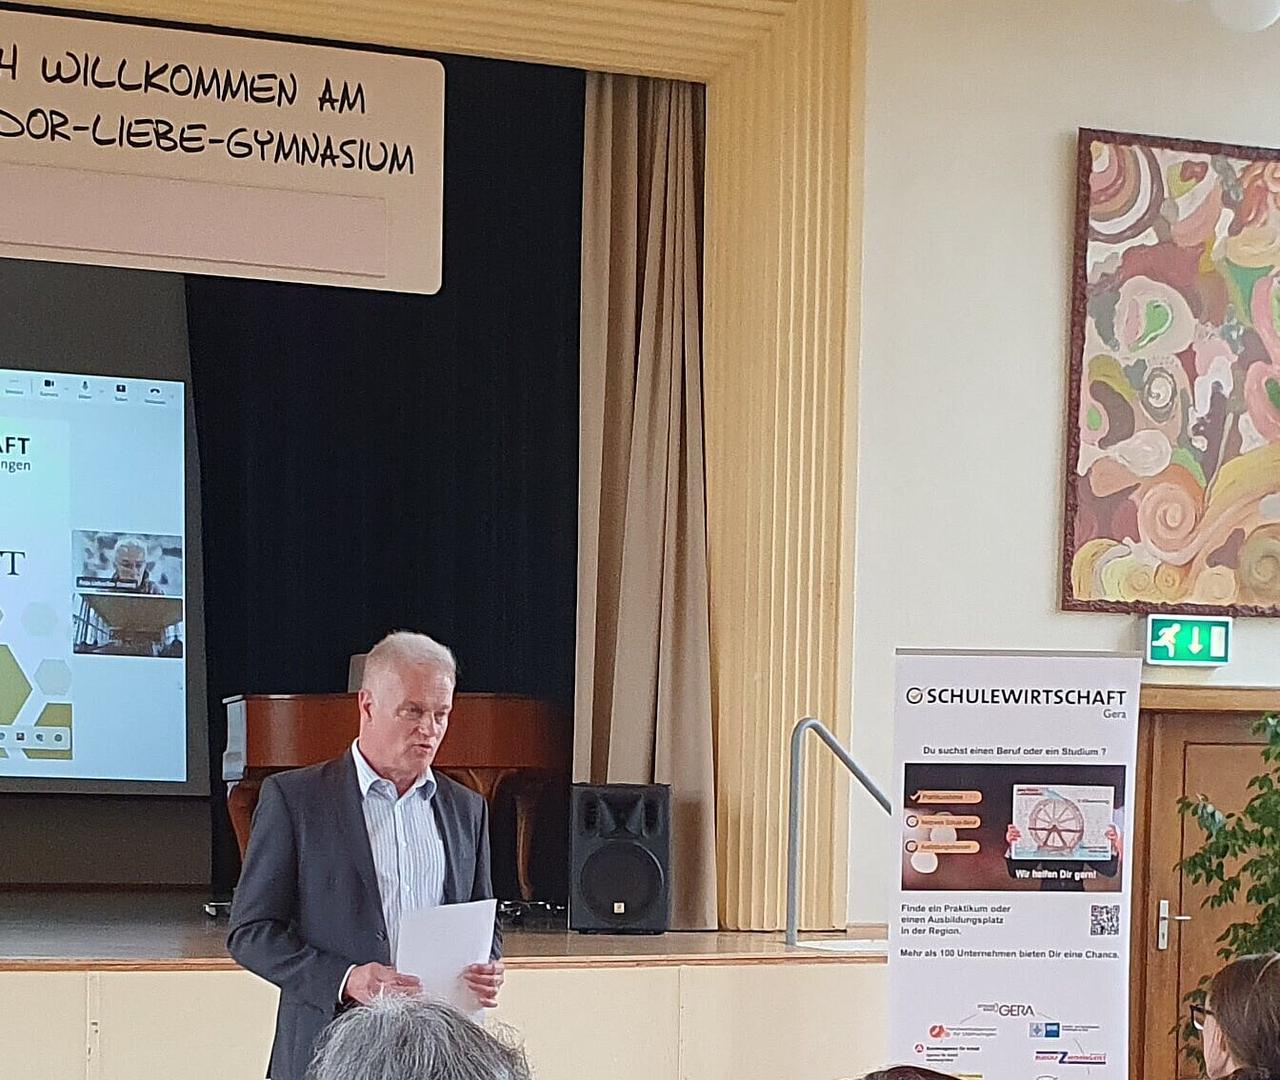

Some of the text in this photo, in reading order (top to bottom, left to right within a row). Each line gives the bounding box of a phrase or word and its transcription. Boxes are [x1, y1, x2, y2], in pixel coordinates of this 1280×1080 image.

[40, 51, 299, 108] WILLKOMMEN
[317, 79, 367, 114] AM
[927, 688, 1127, 706] SCHULEWIRTSCHAFT
[1103, 709, 1127, 719] Gera
[923, 746, 936, 755] Du
[938, 746, 968, 755] suchst
[970, 746, 994, 755] einen
[996, 746, 1021, 756] Beruf
[1023, 747, 1043, 756] oder
[1045, 747, 1059, 756] ein
[1062, 747, 1099, 756] Studium
[901, 904, 1011, 913] Finde ein Praktikum oder
[901, 915, 1004, 926] einen Ausbildungsplatz
[911, 926, 927, 935] der
[900, 949, 923, 957] Mehr
[924, 949, 937, 957] als
[940, 949, 955, 957] 100
[957, 949, 1017, 958] Unternehmen
[1019, 950, 1046, 958] bieten
[1048, 949, 1061, 958] Dir
[1063, 950, 1083, 958] eine
[999, 1004, 1035, 1017] GERA
